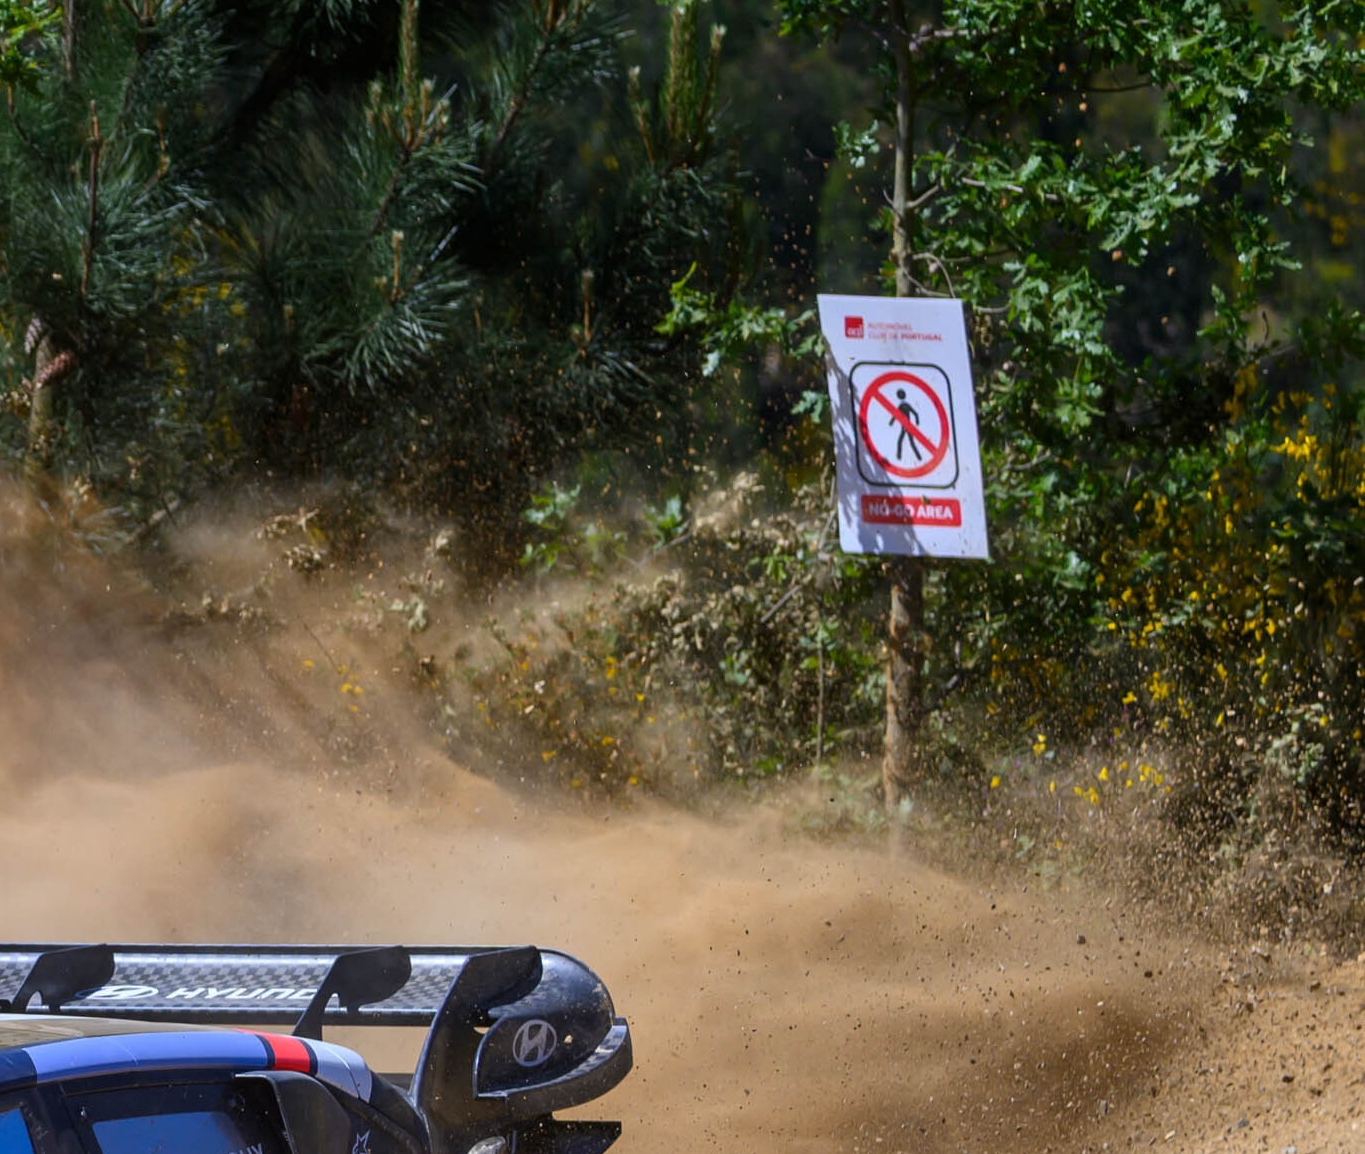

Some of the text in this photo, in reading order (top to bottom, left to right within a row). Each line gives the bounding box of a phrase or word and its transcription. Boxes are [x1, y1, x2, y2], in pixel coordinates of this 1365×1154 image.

[901, 332, 942, 342] PORTUGAL
[869, 502, 953, 520] NO-GO AREA
